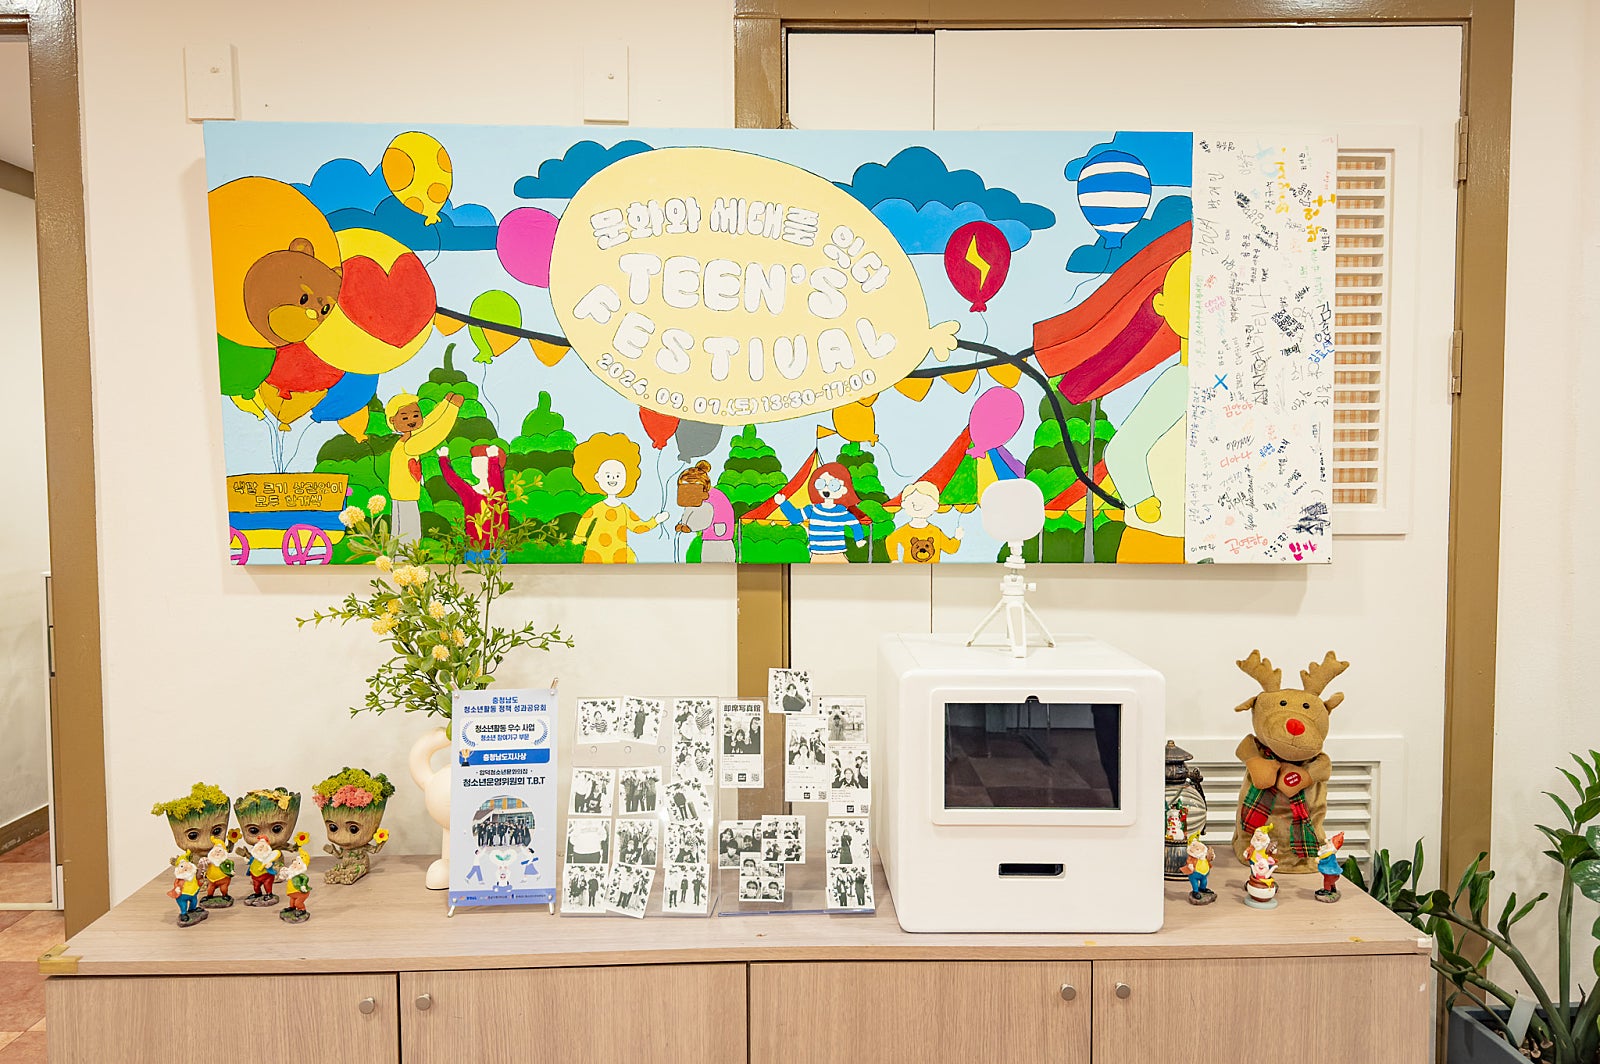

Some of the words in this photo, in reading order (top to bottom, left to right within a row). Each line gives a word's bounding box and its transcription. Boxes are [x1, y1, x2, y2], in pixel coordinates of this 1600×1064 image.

[590, 197, 701, 250] 문화와
[709, 197, 819, 247] 세대를
[618, 253, 848, 319] TEEN'S
[573, 284, 897, 382] FESTIVAL
[596, 353, 649, 399] 2024.
[656, 388, 688, 412] 09.
[255, 495, 279, 507] 모두
[263, 481, 288, 494] 크기
[475, 724, 507, 733] 청소년활동
[522, 723, 535, 732] 사업
[527, 777, 546, 785] T.B.T
